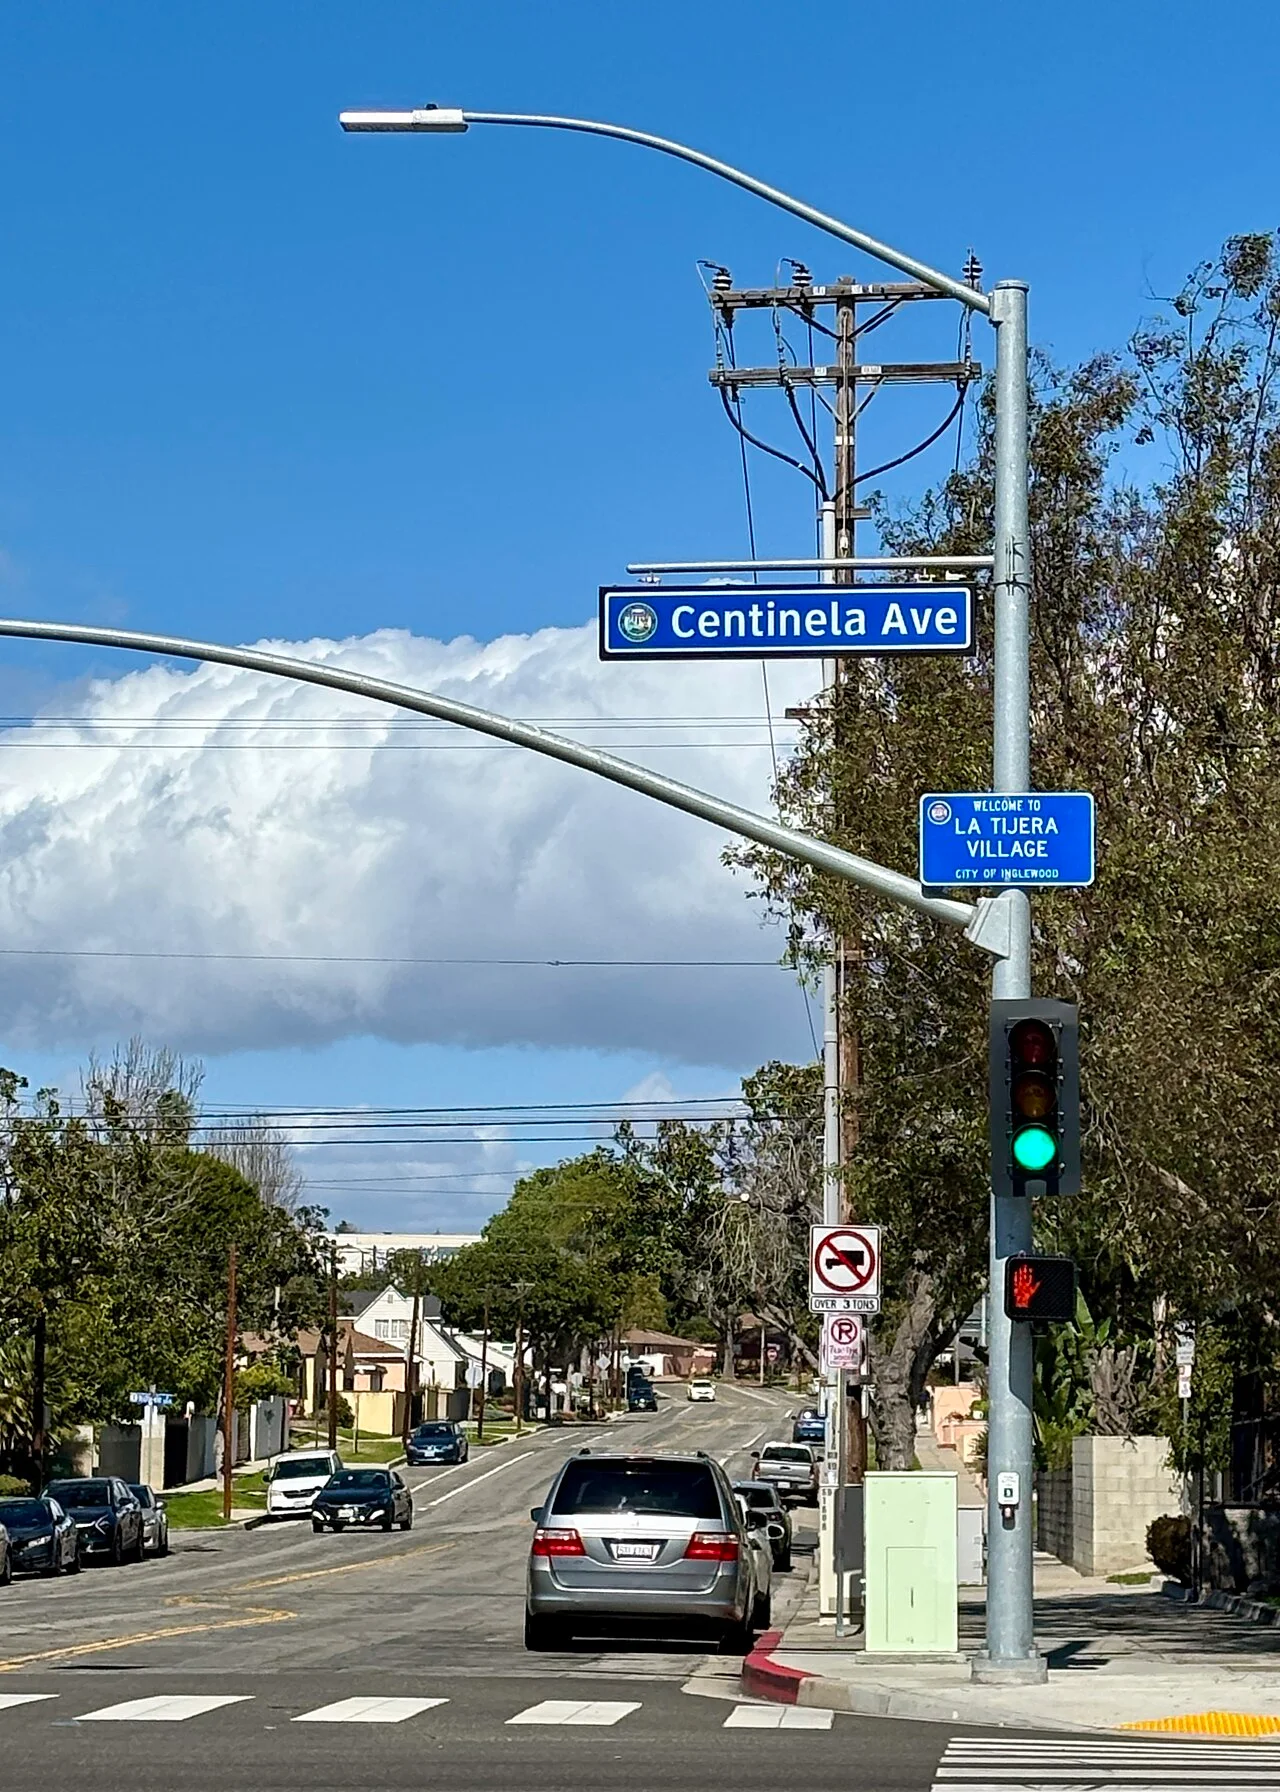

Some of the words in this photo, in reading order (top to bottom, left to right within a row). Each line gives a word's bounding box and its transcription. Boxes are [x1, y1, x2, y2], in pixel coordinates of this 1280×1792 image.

[671, 601, 866, 638] Centinela
[881, 602, 958, 635] Ave
[973, 800, 1023, 812] WELCOME
[1028, 799, 1041, 811] TO
[955, 817, 982, 835] LA
[990, 817, 1059, 835] TIJERA
[966, 840, 1049, 858] VILLAGE
[955, 869, 979, 879] CITY
[983, 869, 997, 879] OF
[1001, 868, 1059, 879] INGLEWOOD
[814, 1299, 837, 1309] OVER
[843, 1299, 850, 1309] 3
[852, 1299, 875, 1310] TONS
